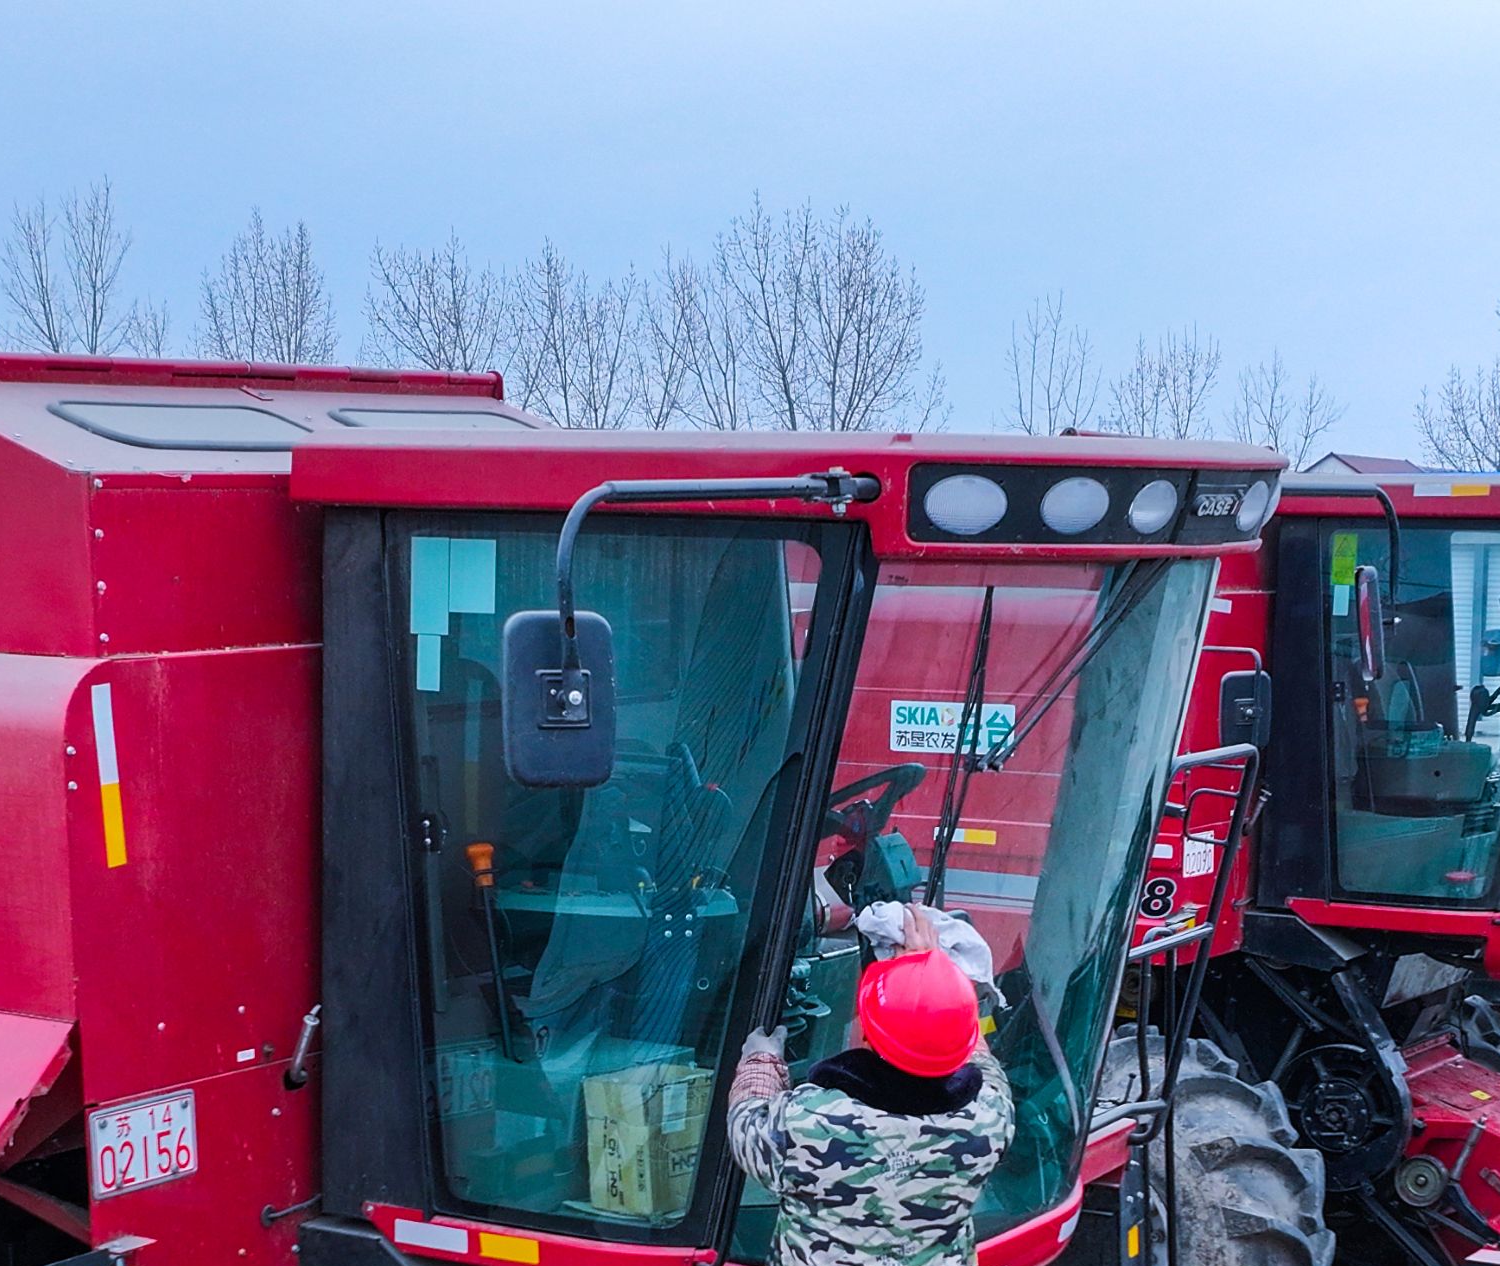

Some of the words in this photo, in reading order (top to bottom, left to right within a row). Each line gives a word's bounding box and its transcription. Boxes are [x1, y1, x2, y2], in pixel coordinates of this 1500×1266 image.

[1197, 499, 1234, 517] CASE
[895, 730, 957, 749] 苏垦农发
[147, 1104, 173, 1131] 14
[100, 1126, 192, 1189] 02156
